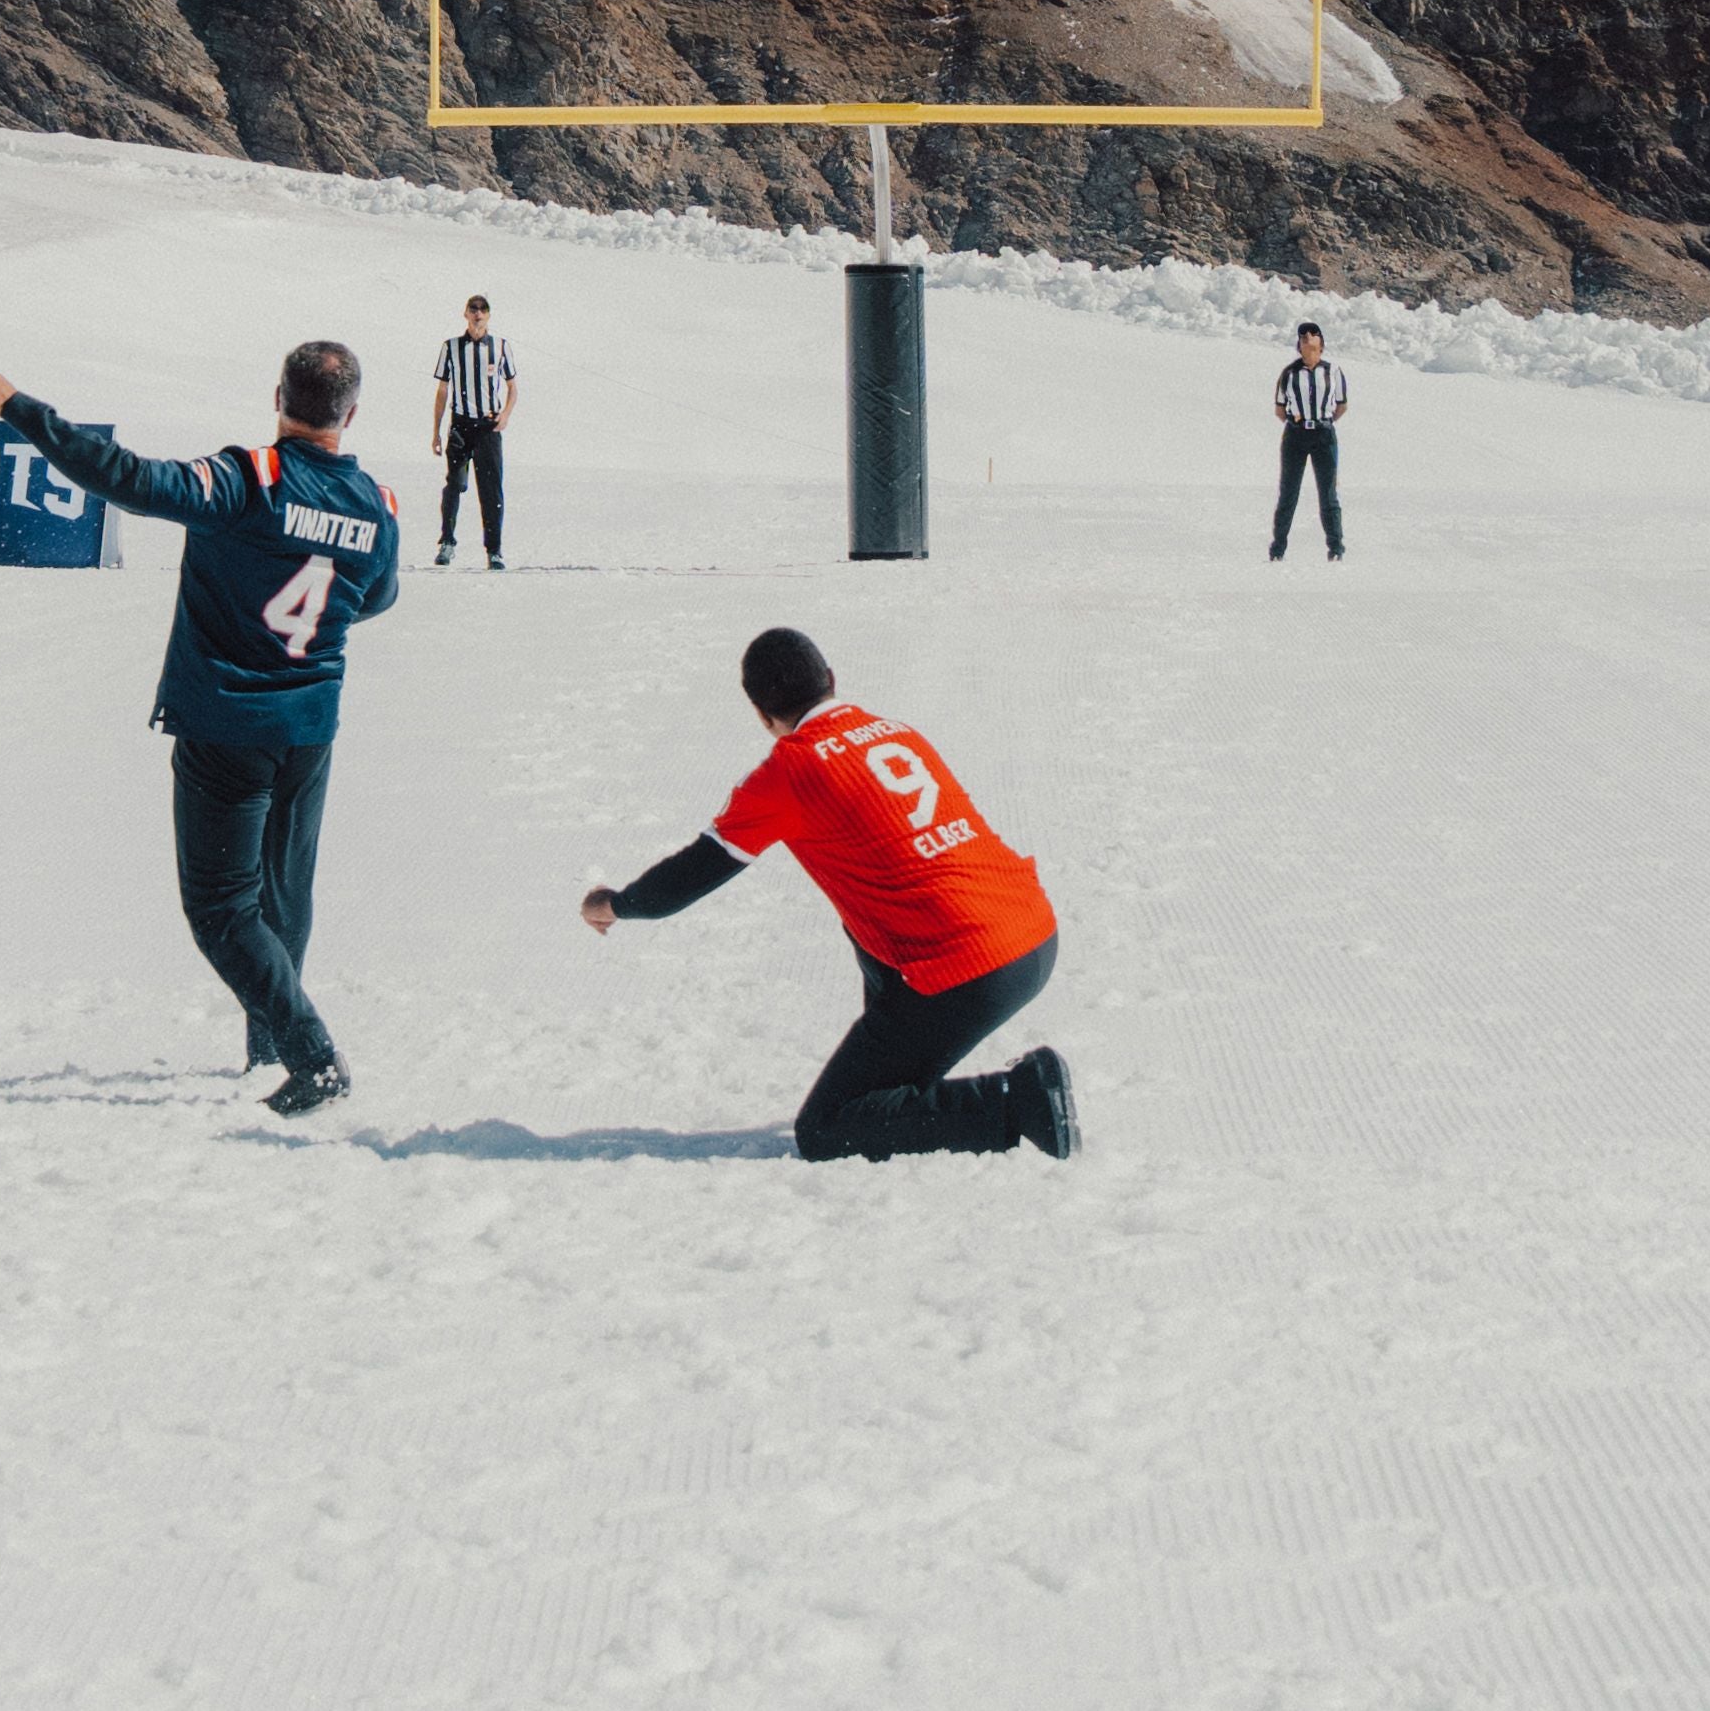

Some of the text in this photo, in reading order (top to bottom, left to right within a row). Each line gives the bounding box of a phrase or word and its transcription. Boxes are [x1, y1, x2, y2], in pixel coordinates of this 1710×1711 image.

[283, 502, 378, 554] VINATIERI
[262, 554, 336, 659] 4
[814, 737, 847, 761] FC
[865, 742, 940, 830] 9
[913, 817, 979, 860] ELBER
